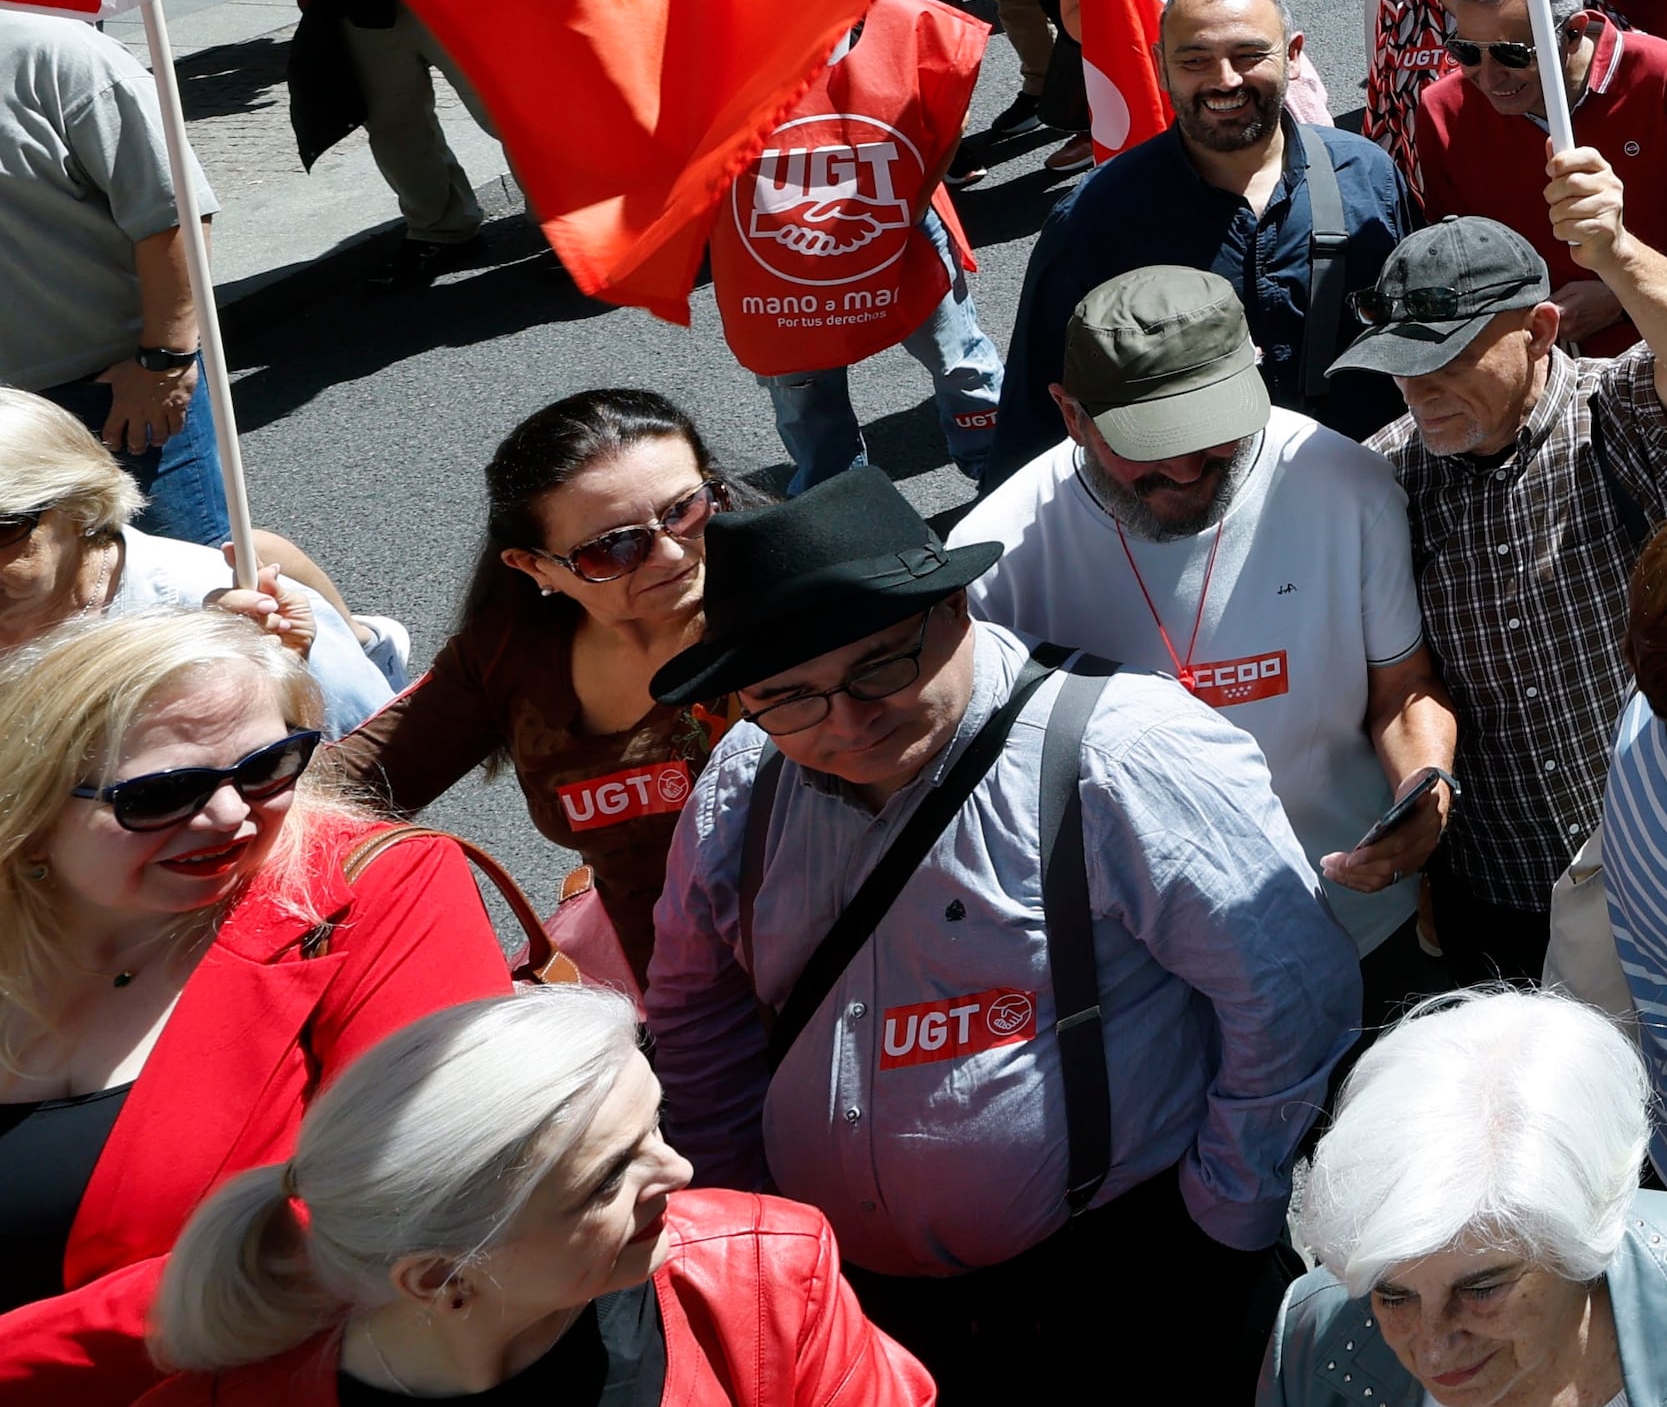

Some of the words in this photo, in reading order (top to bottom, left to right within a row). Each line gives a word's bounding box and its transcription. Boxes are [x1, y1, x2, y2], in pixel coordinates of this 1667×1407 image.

[1403, 49, 1444, 67] UGT
[754, 141, 899, 211] UGT
[743, 294, 817, 314] mano
[825, 298, 836, 311] a
[777, 316, 799, 328] Por
[801, 315, 824, 328] tus
[826, 311, 888, 326] derechos
[956, 411, 998, 428] UGT
[1192, 657, 1281, 688] CCOO
[561, 774, 652, 822] UGT
[884, 1004, 980, 1057] UGT
